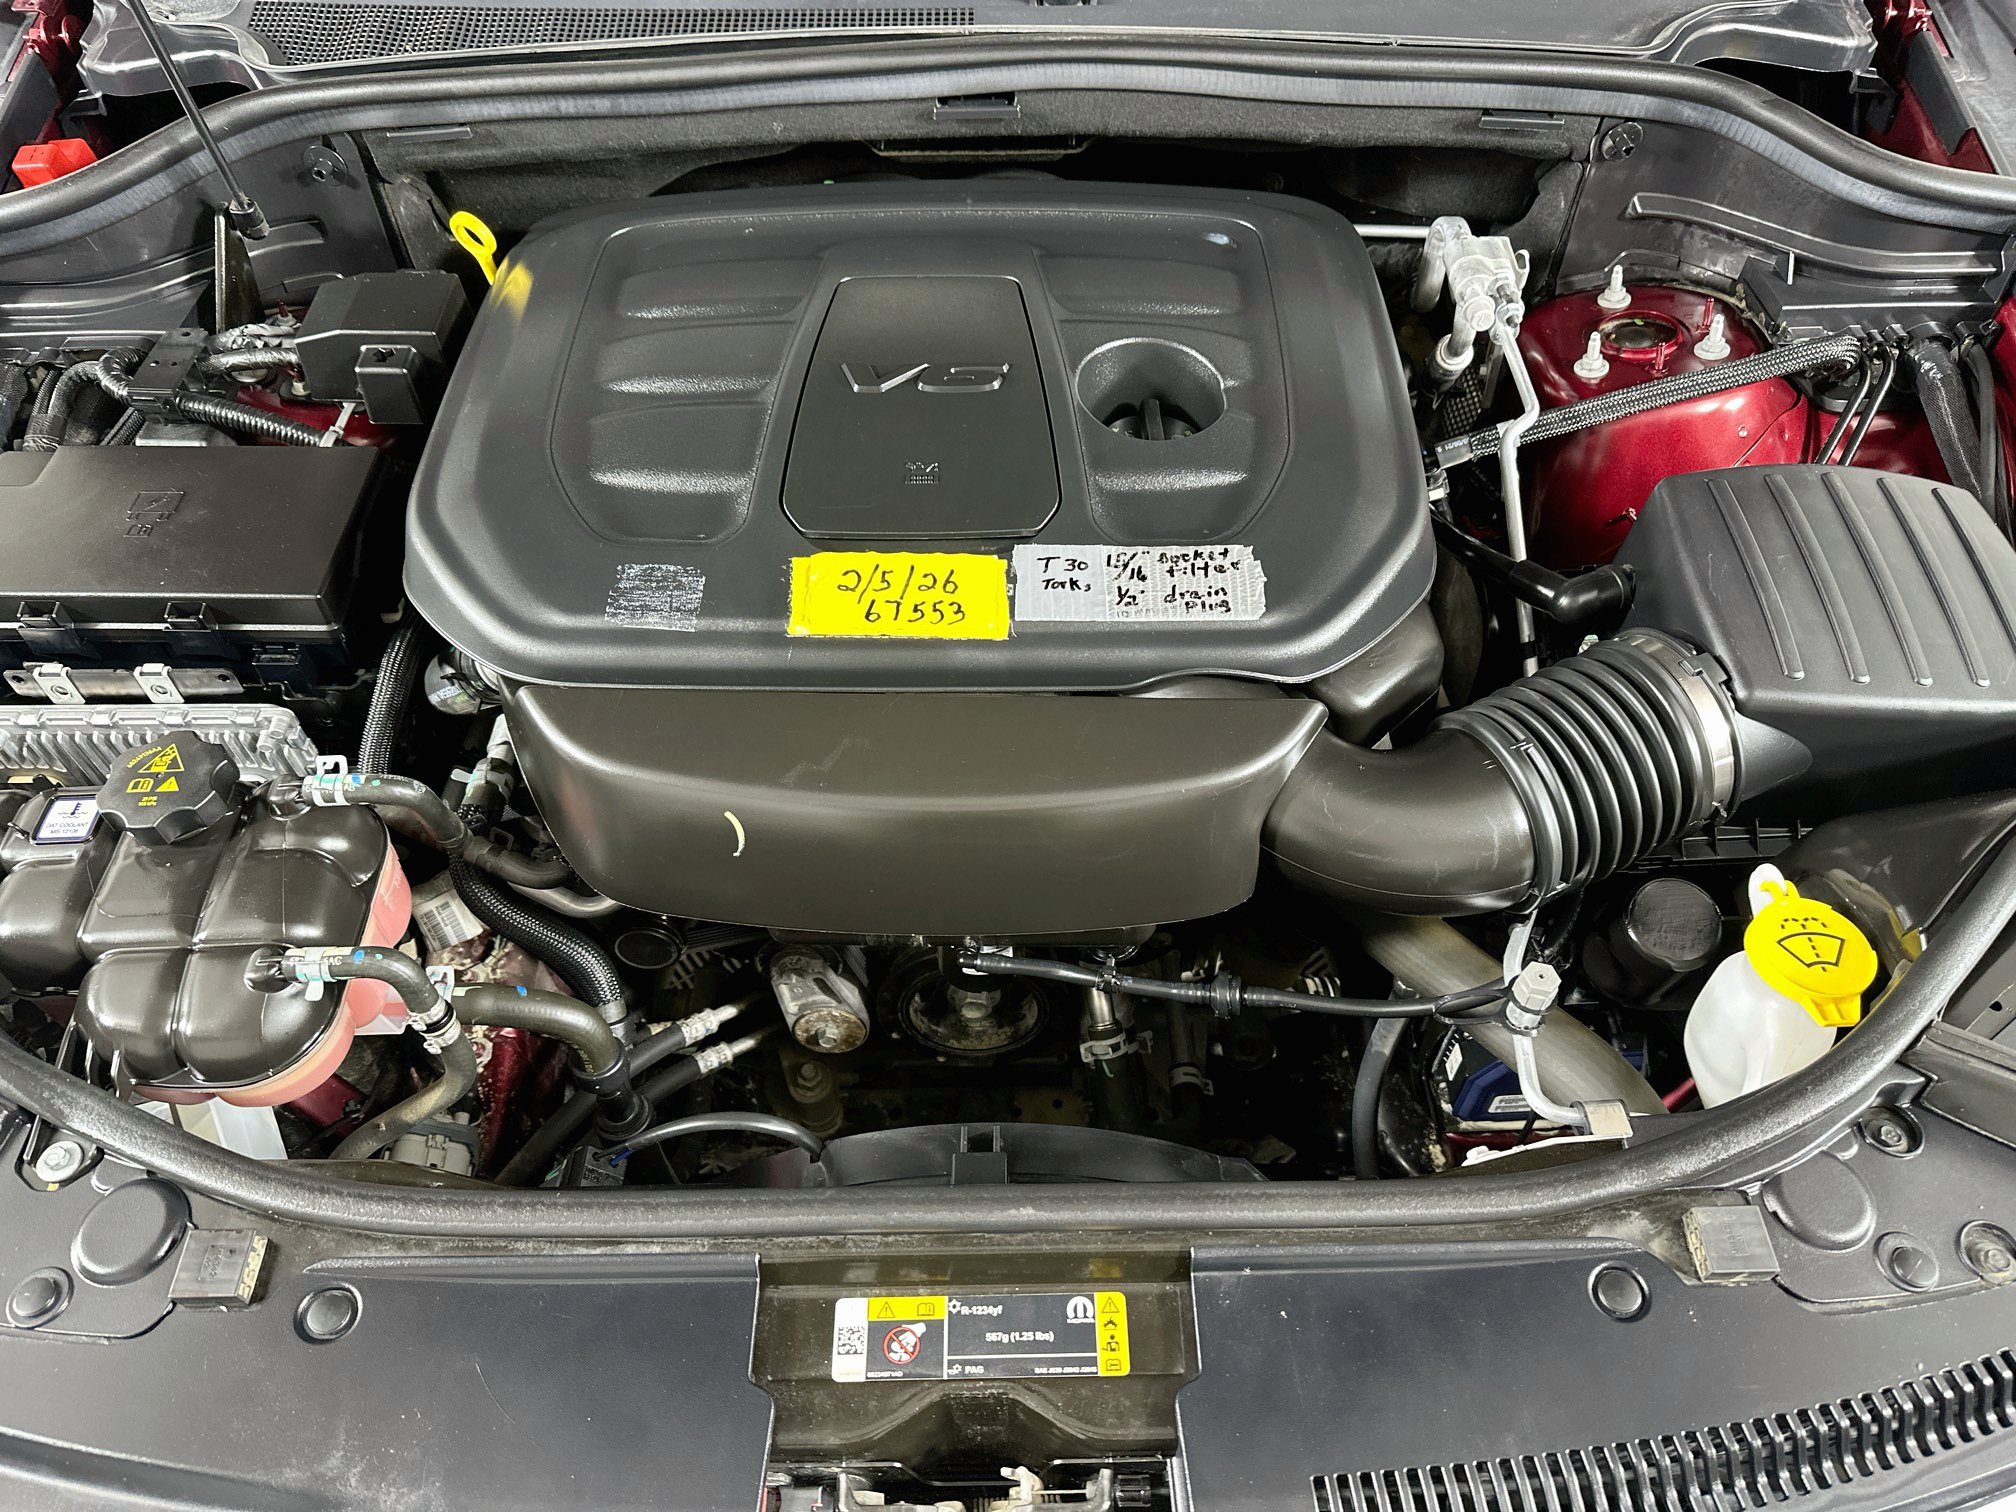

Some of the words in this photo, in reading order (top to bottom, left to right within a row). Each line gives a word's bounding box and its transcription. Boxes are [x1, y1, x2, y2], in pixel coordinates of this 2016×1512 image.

[840, 362, 1012, 393] V6
[1036, 556, 1061, 573] T
[1063, 557, 1089, 572] 30
[837, 563, 959, 605] 2/5/26
[1164, 584, 1228, 604] drain
[864, 598, 966, 626] 67553
[1185, 599, 1231, 614] plug
[960, 1304, 1003, 1317] R-1234yf
[985, 1331, 1009, 1344] 567g
[1010, 1331, 1034, 1343] (1.25
[1035, 1330, 1055, 1343] lbs)
[964, 1365, 984, 1374] PAG
